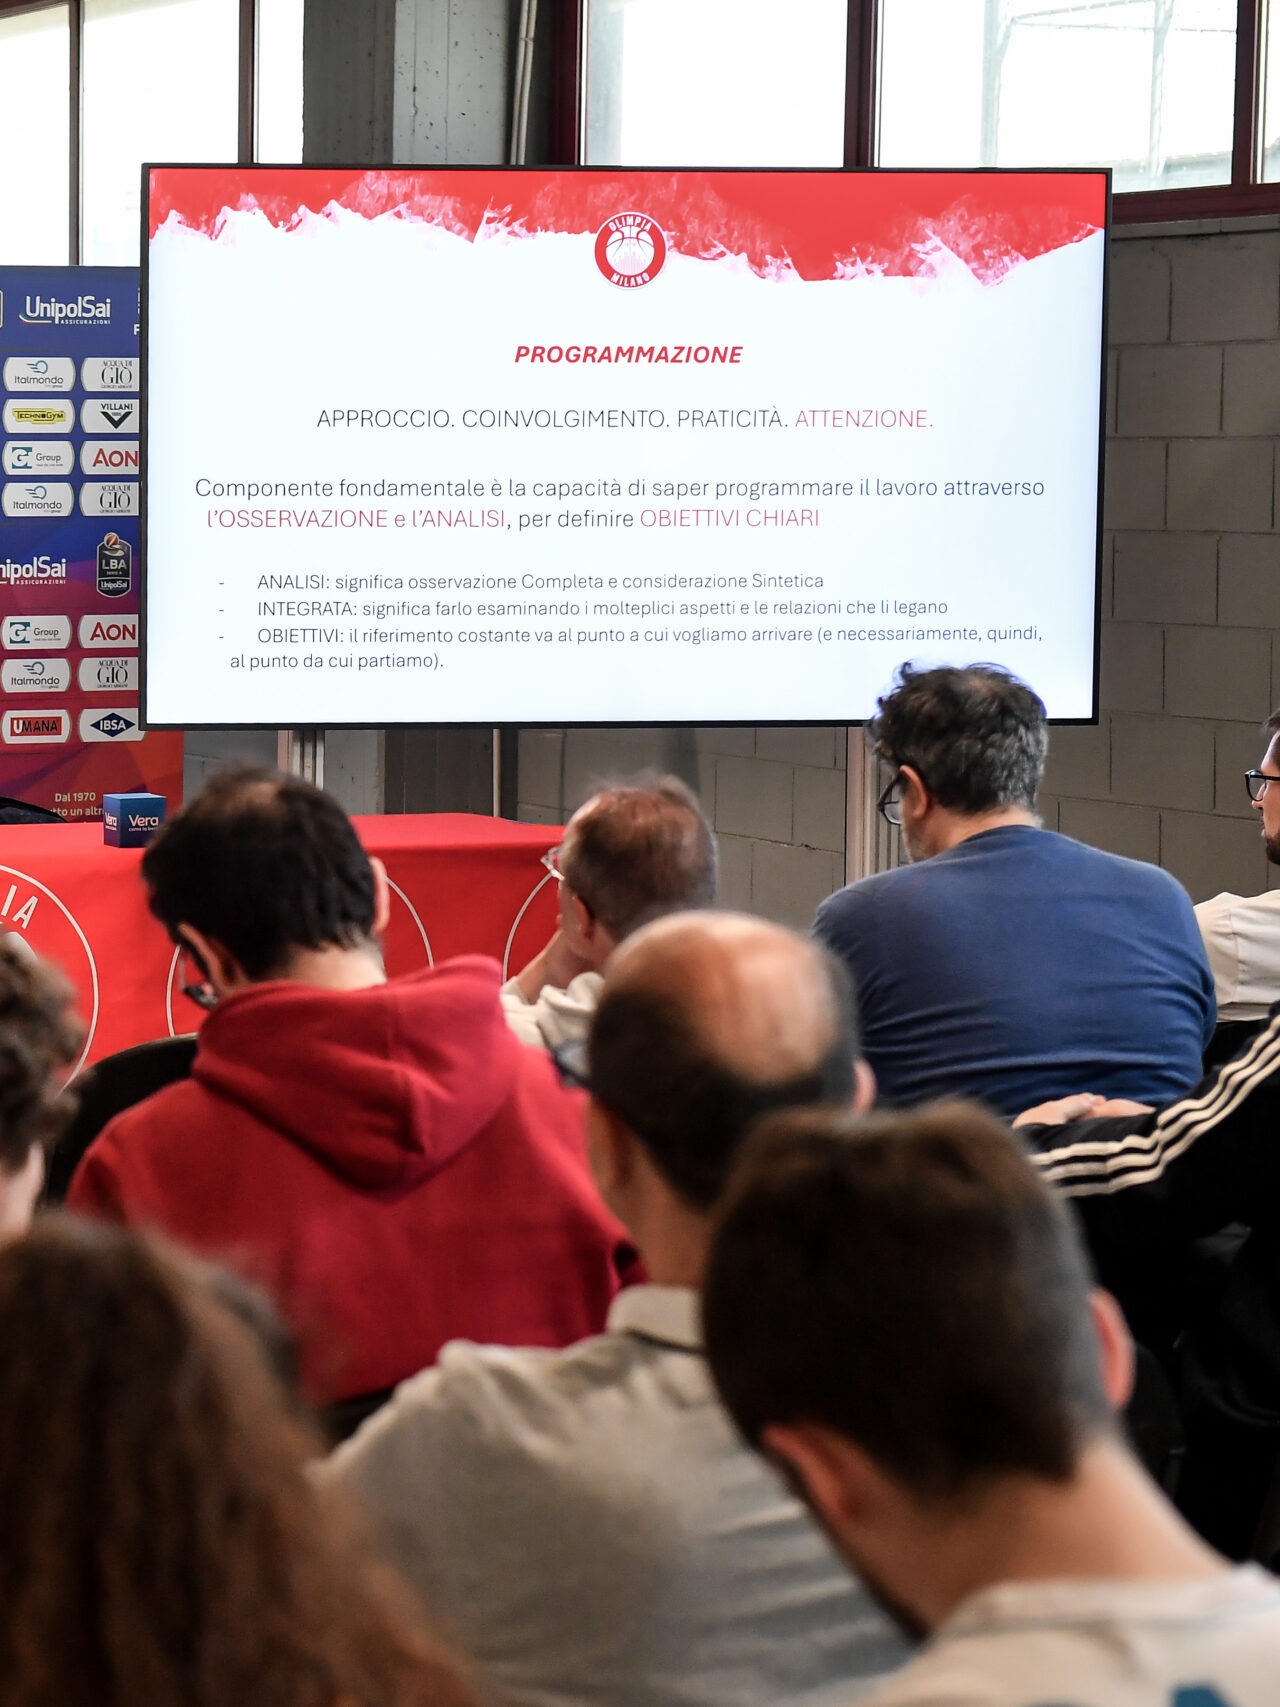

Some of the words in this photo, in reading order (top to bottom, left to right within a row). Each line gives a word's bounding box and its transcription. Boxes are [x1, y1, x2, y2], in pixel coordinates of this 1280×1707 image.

[608, 215, 653, 232] OLIMPIA
[610, 272, 650, 287] MILANO
[25, 295, 111, 324] UnipolSai
[514, 343, 744, 365] PROGRAMMAZIONE
[14, 375, 64, 384] Italmondo
[101, 403, 133, 411] VILLANI
[316, 408, 455, 429] APPROCCIO.
[462, 408, 670, 429] COINVOLGIMENTO.
[677, 404, 789, 429] PRATICITÀ.
[794, 409, 934, 428] ATTENZIONE.
[35, 453, 62, 463] Group
[92, 448, 139, 467] AON
[195, 477, 334, 502] Componente
[338, 478, 485, 497] fondamentale
[490, 477, 503, 497] è
[509, 477, 526, 497] la
[532, 477, 622, 501] capacità
[627, 478, 646, 497] di
[652, 482, 710, 501] saper
[715, 481, 854, 501] programmare
[859, 477, 871, 497] il
[876, 477, 938, 497] lavoro
[943, 479, 1045, 497] attraverso
[394, 513, 406, 528] e
[518, 513, 552, 533] per
[557, 509, 634, 528] definire
[640, 508, 741, 529] OBIETTIVI
[746, 508, 819, 528] CHIARI
[256, 573, 330, 590] ANALISI:
[335, 573, 404, 593] significa
[407, 573, 517, 590] osservazione
[521, 573, 604, 592] Completa
[607, 576, 618, 589] e
[622, 573, 748, 589] considerazione
[751, 572, 824, 589] Sintetica
[258, 600, 358, 617] INTEGRATA:
[362, 600, 431, 620] significa
[435, 600, 473, 616] farlo
[476, 600, 580, 616] esaminando
[584, 600, 588, 616] i
[593, 600, 675, 619] molteplici
[679, 600, 736, 619] aspetti
[739, 603, 750, 615] e
[754, 599, 769, 615] le
[773, 599, 842, 615] relazioni
[846, 599, 877, 615] che
[880, 599, 889, 615] li
[893, 599, 949, 618] legano
[33, 627, 59, 637] Group
[89, 621, 136, 641] AON
[257, 627, 344, 644] OBIETTIVI:
[349, 627, 359, 644] il
[362, 627, 454, 644] riferimento
[457, 629, 531, 643] costante
[534, 630, 553, 643] va
[557, 627, 573, 643] al
[577, 628, 625, 646] punto
[629, 630, 640, 642] a
[643, 626, 669, 642] cui
[672, 626, 747, 646] vogliamo
[751, 626, 813, 642] arrivare
[817, 626, 833, 645] (e
[837, 625, 982, 643] necessariamente,
[986, 624, 1043, 644] quindi,
[229, 653, 246, 669] al
[249, 654, 299, 672] punto
[302, 652, 324, 669] da
[328, 652, 353, 669] cui
[358, 652, 444, 672] partiamo).
[10, 676, 60, 686] Italmondo
[13, 719, 58, 734] UMANA
[99, 719, 127, 731] IBSA
[55, 792, 71, 802] Dal
[73, 792, 96, 802] 1970
[128, 814, 159, 827] Vera
